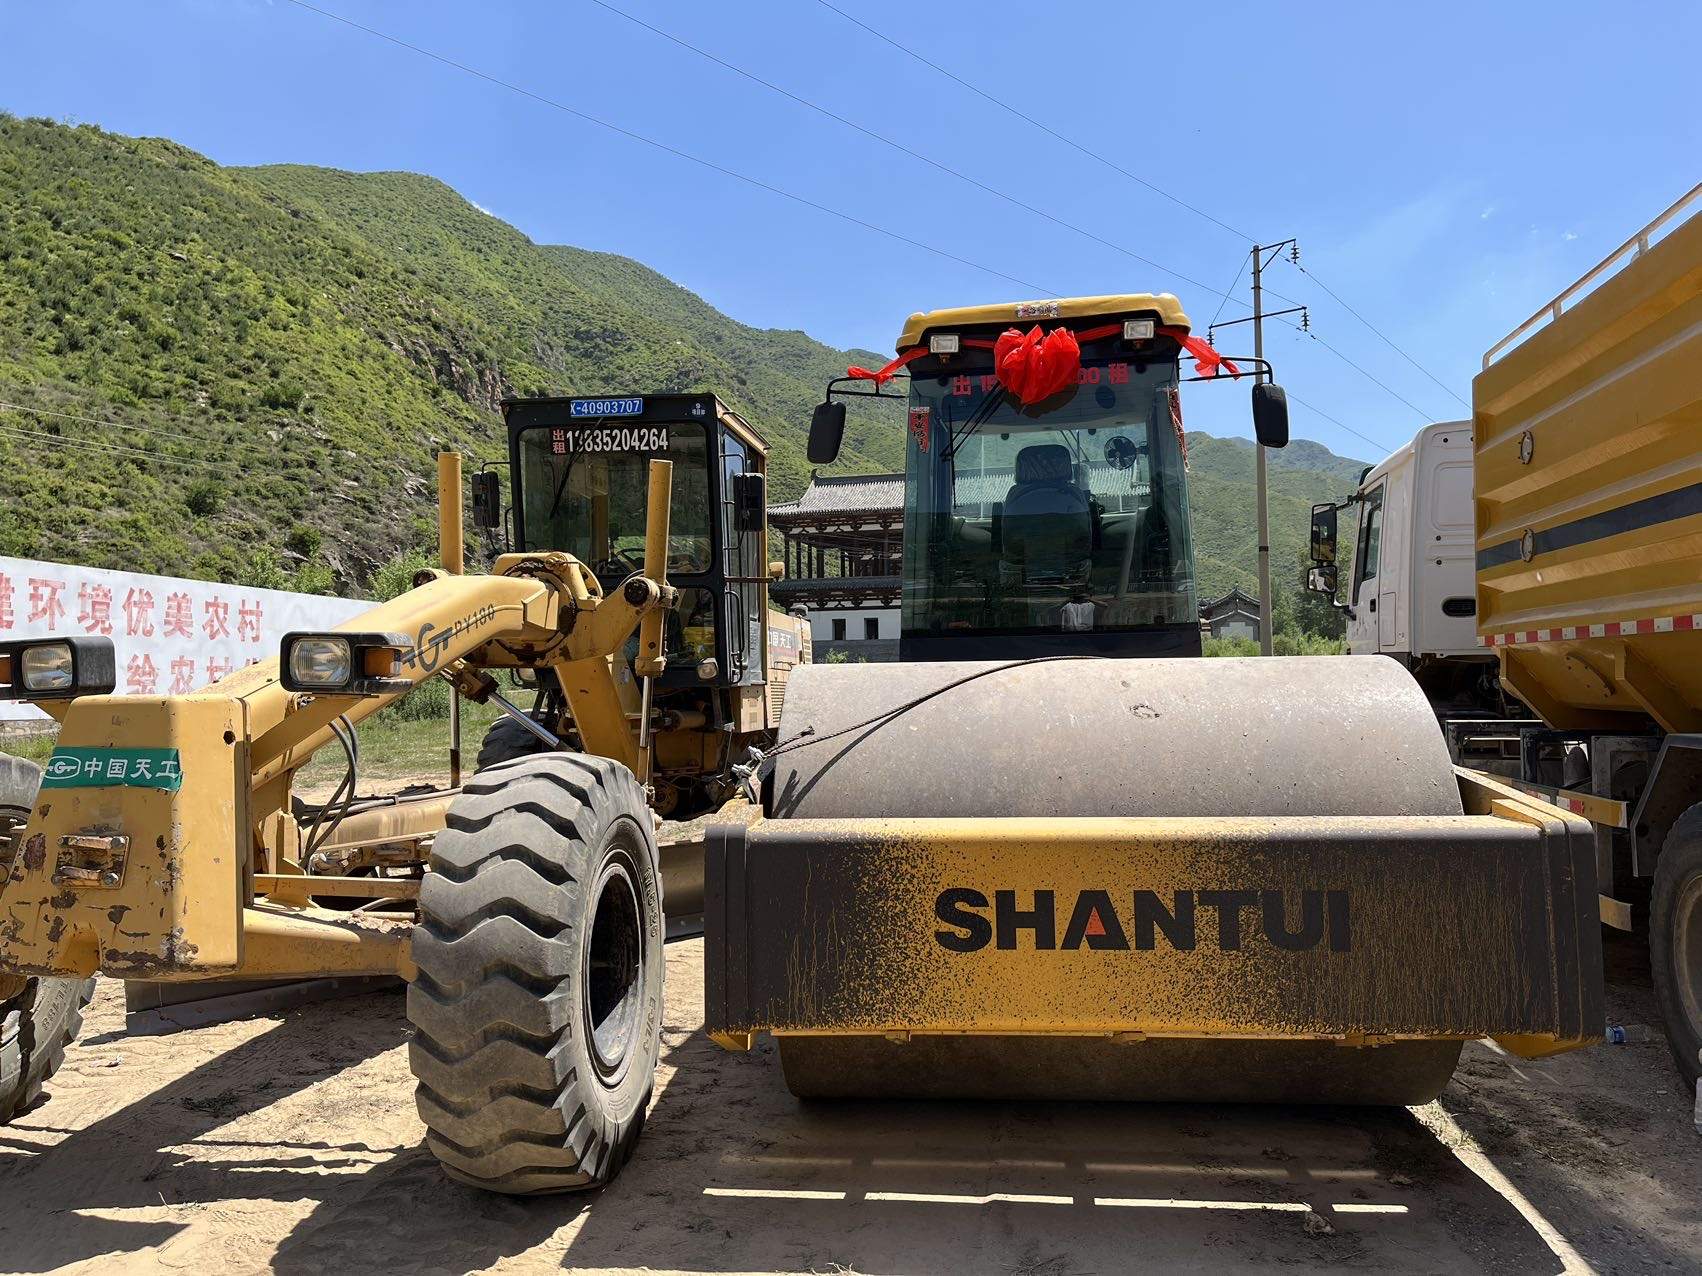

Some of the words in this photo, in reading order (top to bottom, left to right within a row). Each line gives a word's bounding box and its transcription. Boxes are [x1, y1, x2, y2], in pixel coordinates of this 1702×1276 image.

[553, 429, 566, 453] 出租
[84, 758, 178, 779] 中国天工
[935, 887, 1351, 952] SHANTUI
